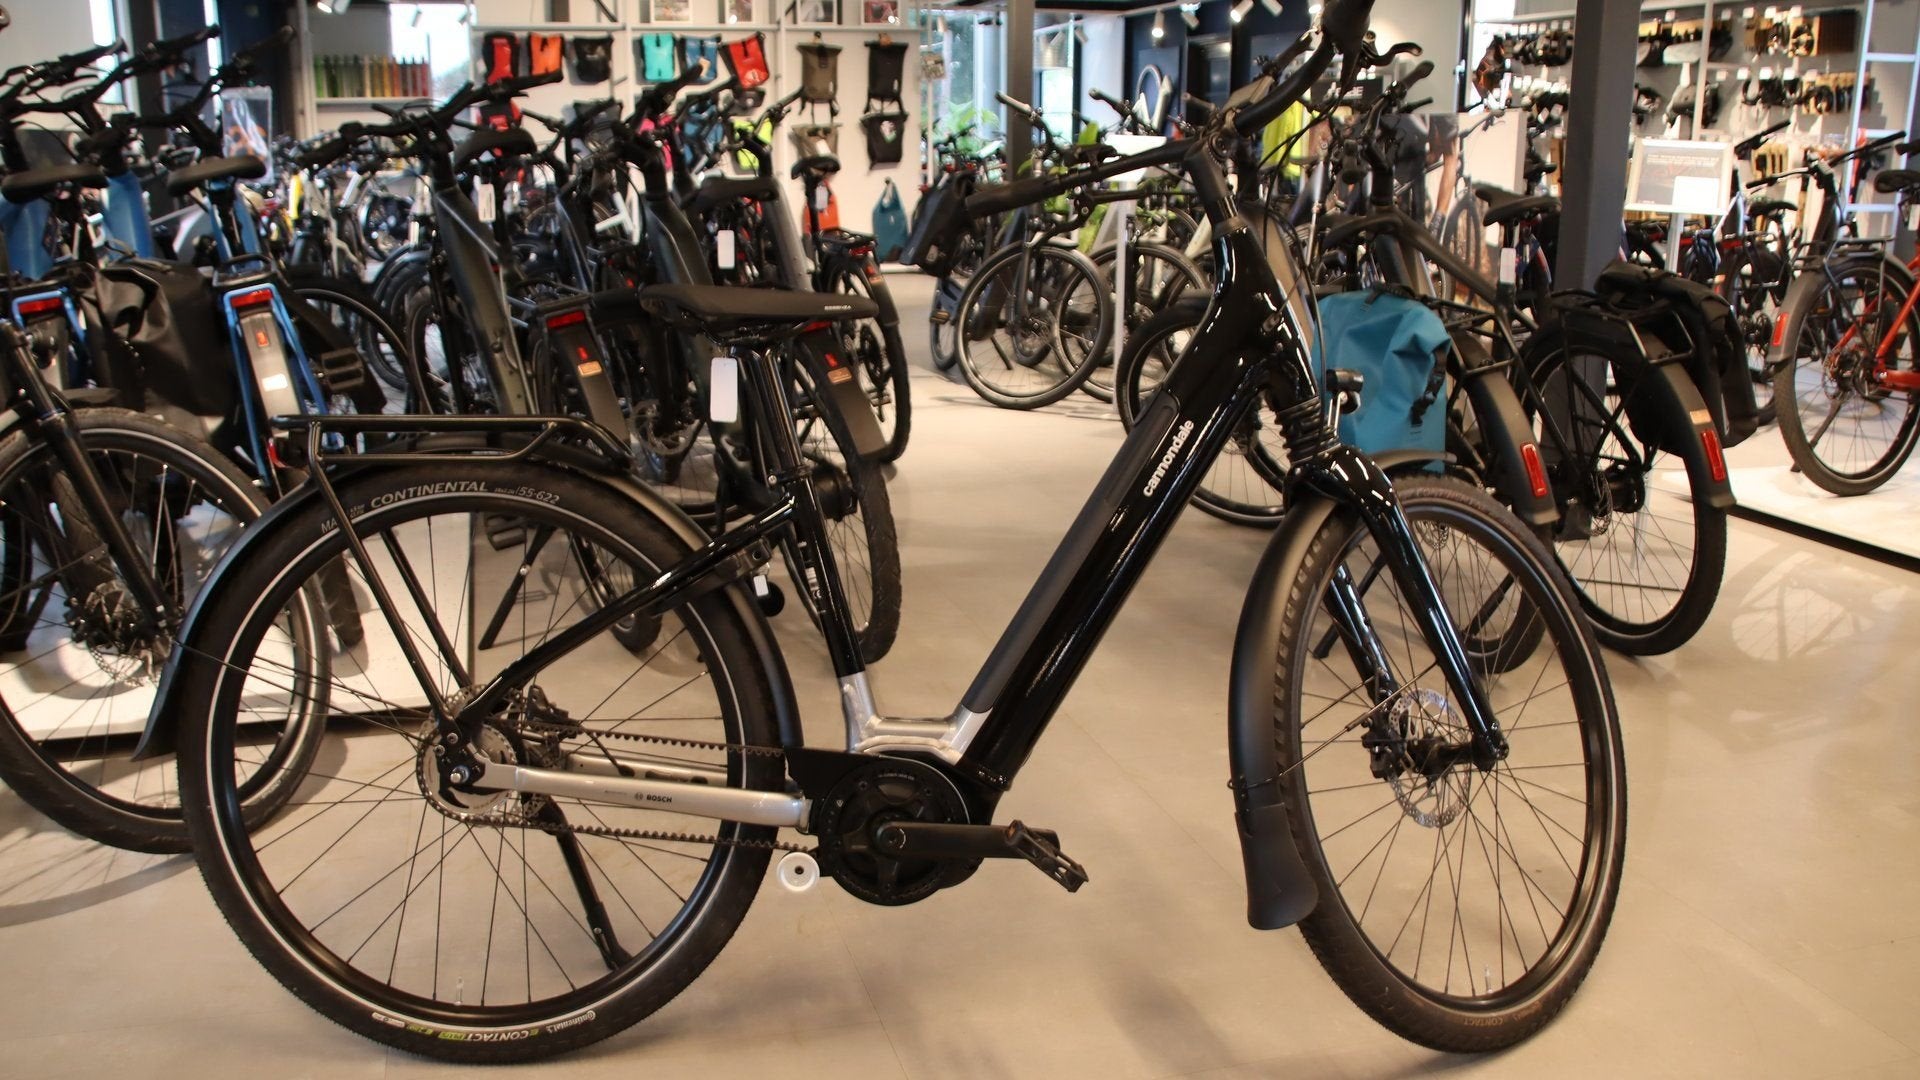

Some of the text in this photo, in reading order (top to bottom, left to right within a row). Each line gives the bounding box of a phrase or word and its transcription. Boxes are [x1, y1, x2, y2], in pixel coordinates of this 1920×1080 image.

[1143, 419, 1195, 497] cannondale
[370, 481, 488, 508] CONTINENTAL
[646, 794, 672, 802] BOSCH
[553, 1010, 596, 1032] Continental
